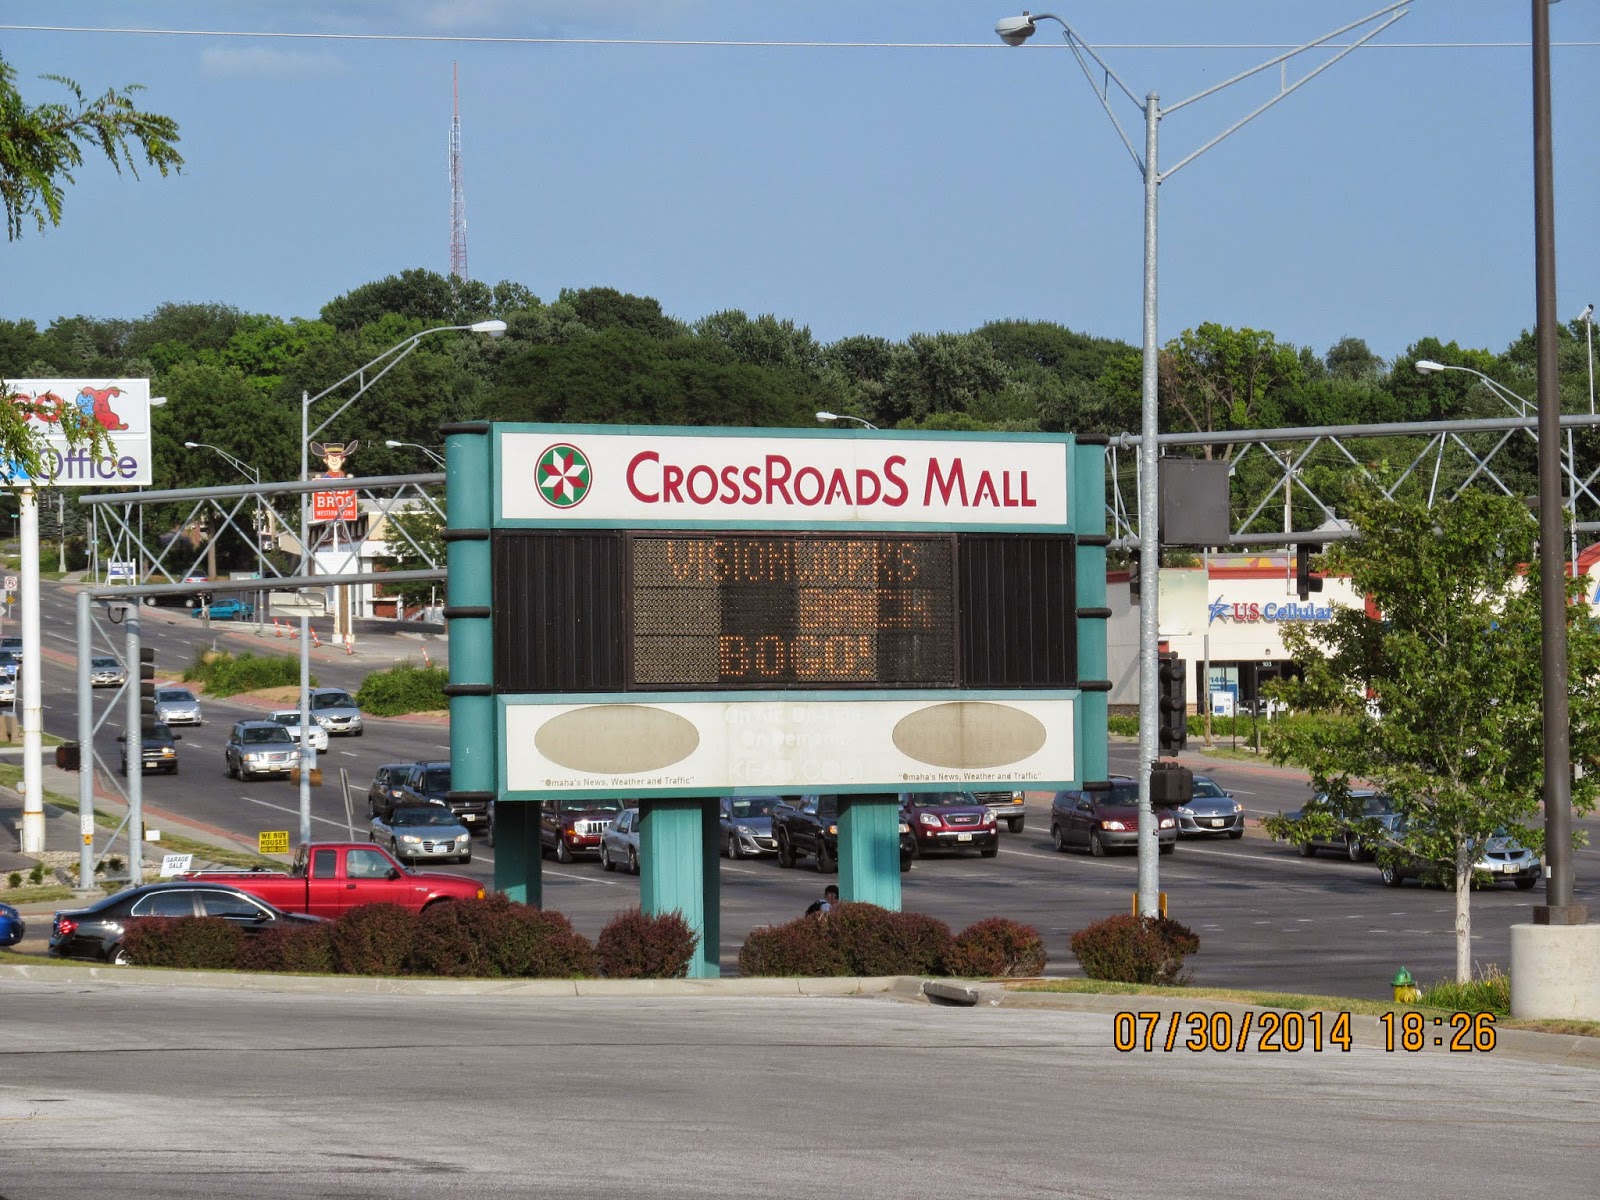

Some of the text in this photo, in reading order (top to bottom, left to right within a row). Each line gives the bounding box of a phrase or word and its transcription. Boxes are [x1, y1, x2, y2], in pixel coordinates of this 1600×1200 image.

[38, 447, 138, 480] Office
[317, 496, 354, 508] BROS
[1233, 602, 1333, 620] US Cellular
[719, 634, 871, 676] BOGO!
[611, 777, 644, 786] Weather
[647, 777, 662, 785] and
[963, 772, 995, 780] Weather
[997, 772, 1012, 780] and
